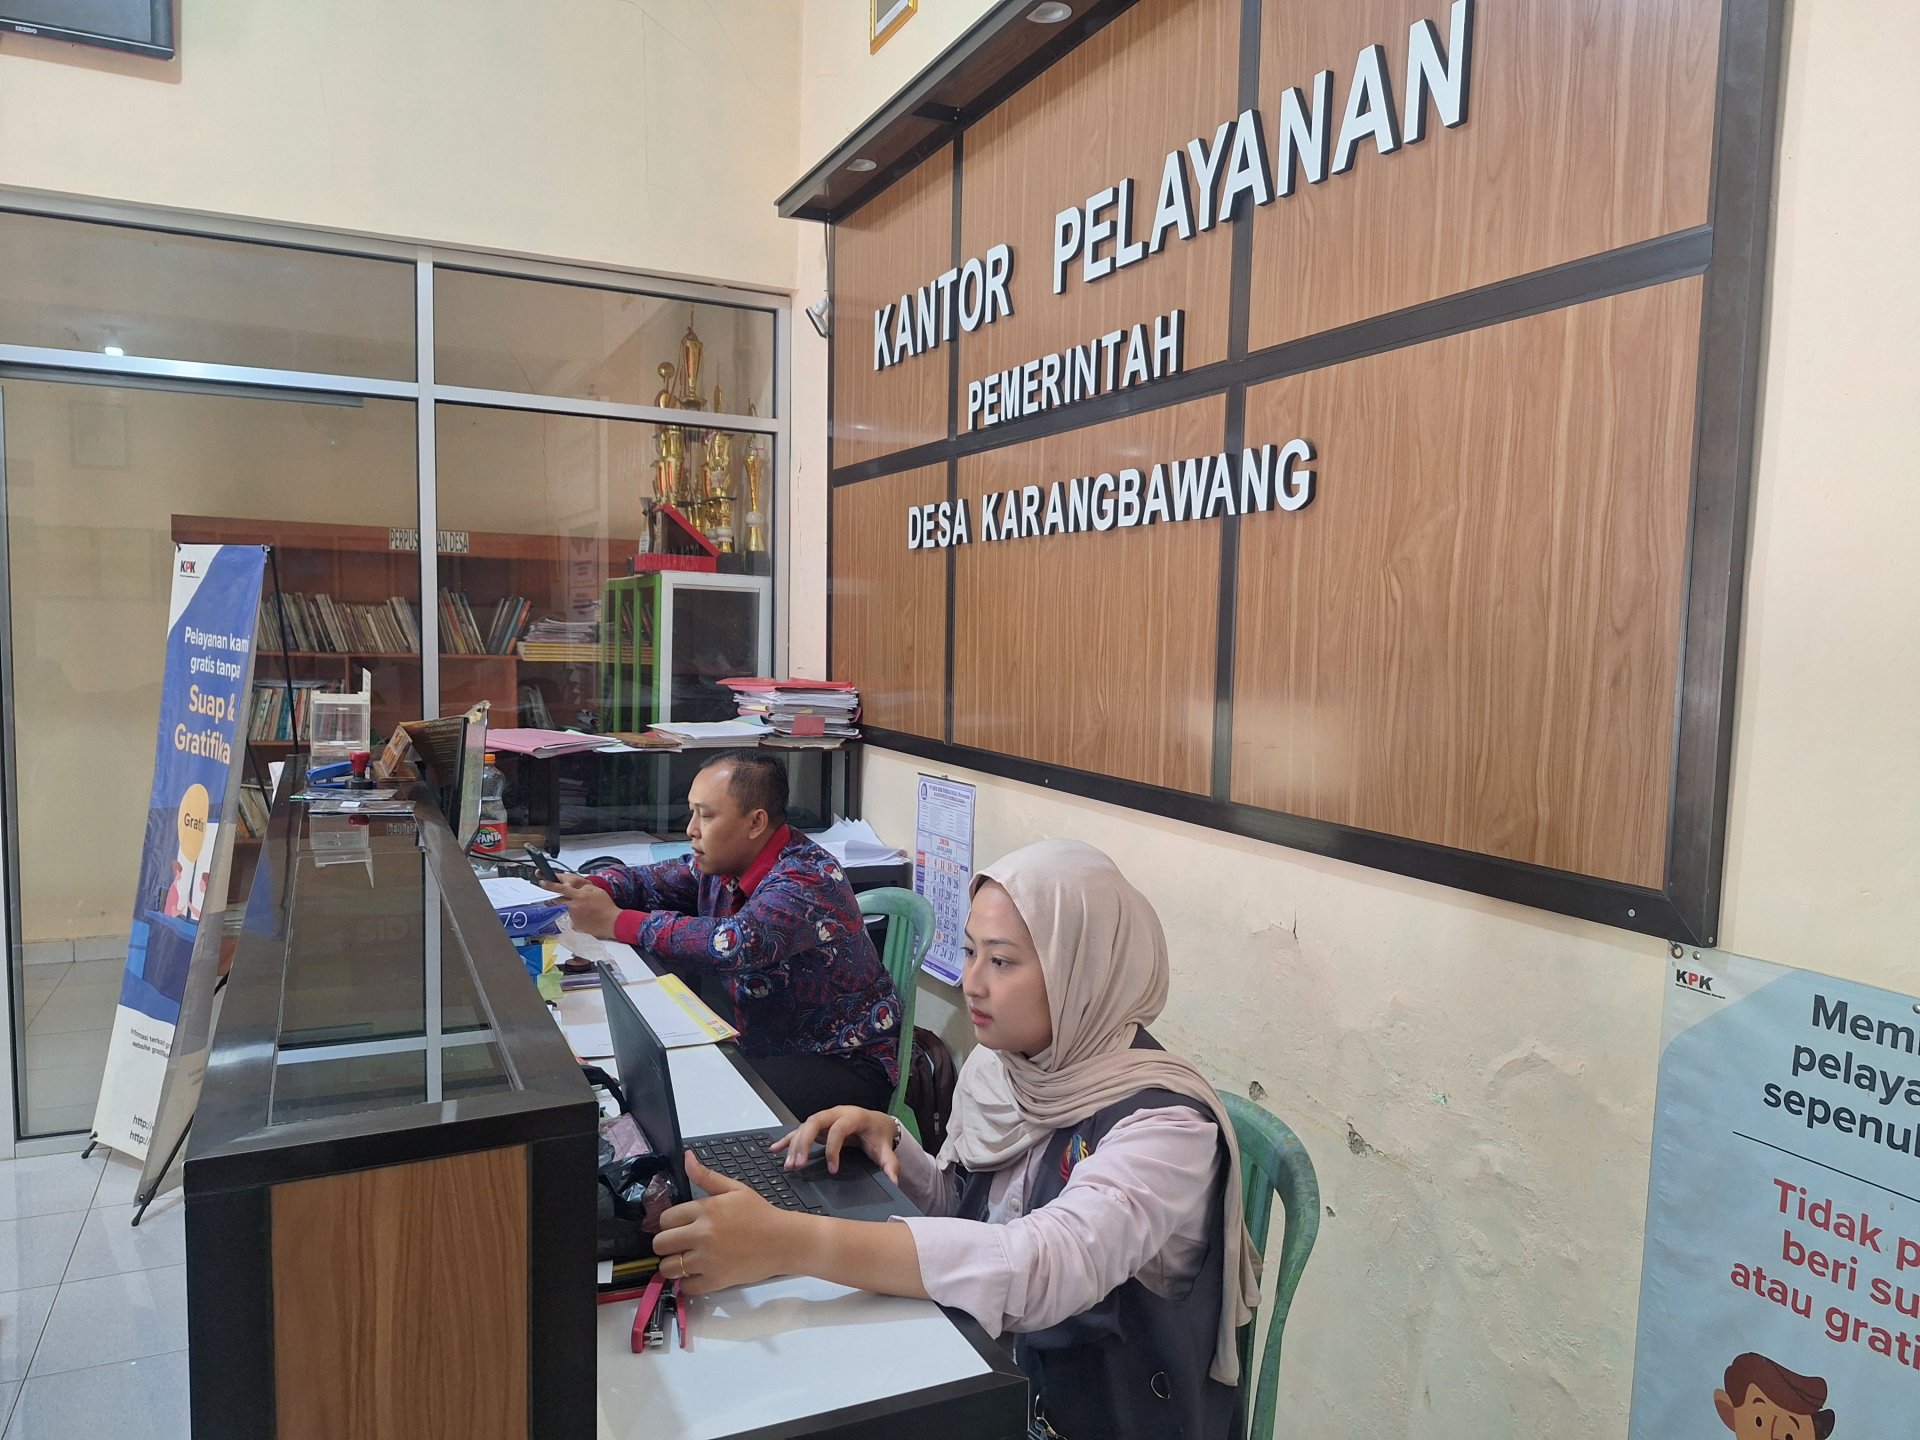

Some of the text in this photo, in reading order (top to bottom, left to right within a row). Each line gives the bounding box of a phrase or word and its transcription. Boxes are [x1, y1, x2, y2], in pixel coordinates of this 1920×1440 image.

[874, 0, 1473, 371] KANTOR PELAYANAN
[968, 309, 1184, 430] PEMERINTAH
[908, 438, 1316, 549] DESA KARANGBAWANG
[449, 532, 469, 552] DESA
[180, 560, 196, 573] KPK
[185, 626, 250, 653] Pelayanan kami
[190, 655, 241, 682] gratis tanpa
[189, 684, 235, 724] Suap &
[174, 723, 231, 765] Gratifika
[477, 831, 502, 844] FANTA
[499, 911, 528, 929] 70
[1676, 968, 1714, 991] KPK
[1812, 994, 1920, 1056] Mem
[1763, 1082, 1920, 1158] sepenu
[1773, 1177, 1920, 1272] Tidak p
[1730, 1262, 1813, 1320] atau
[1782, 1229, 1920, 1320] beri su
